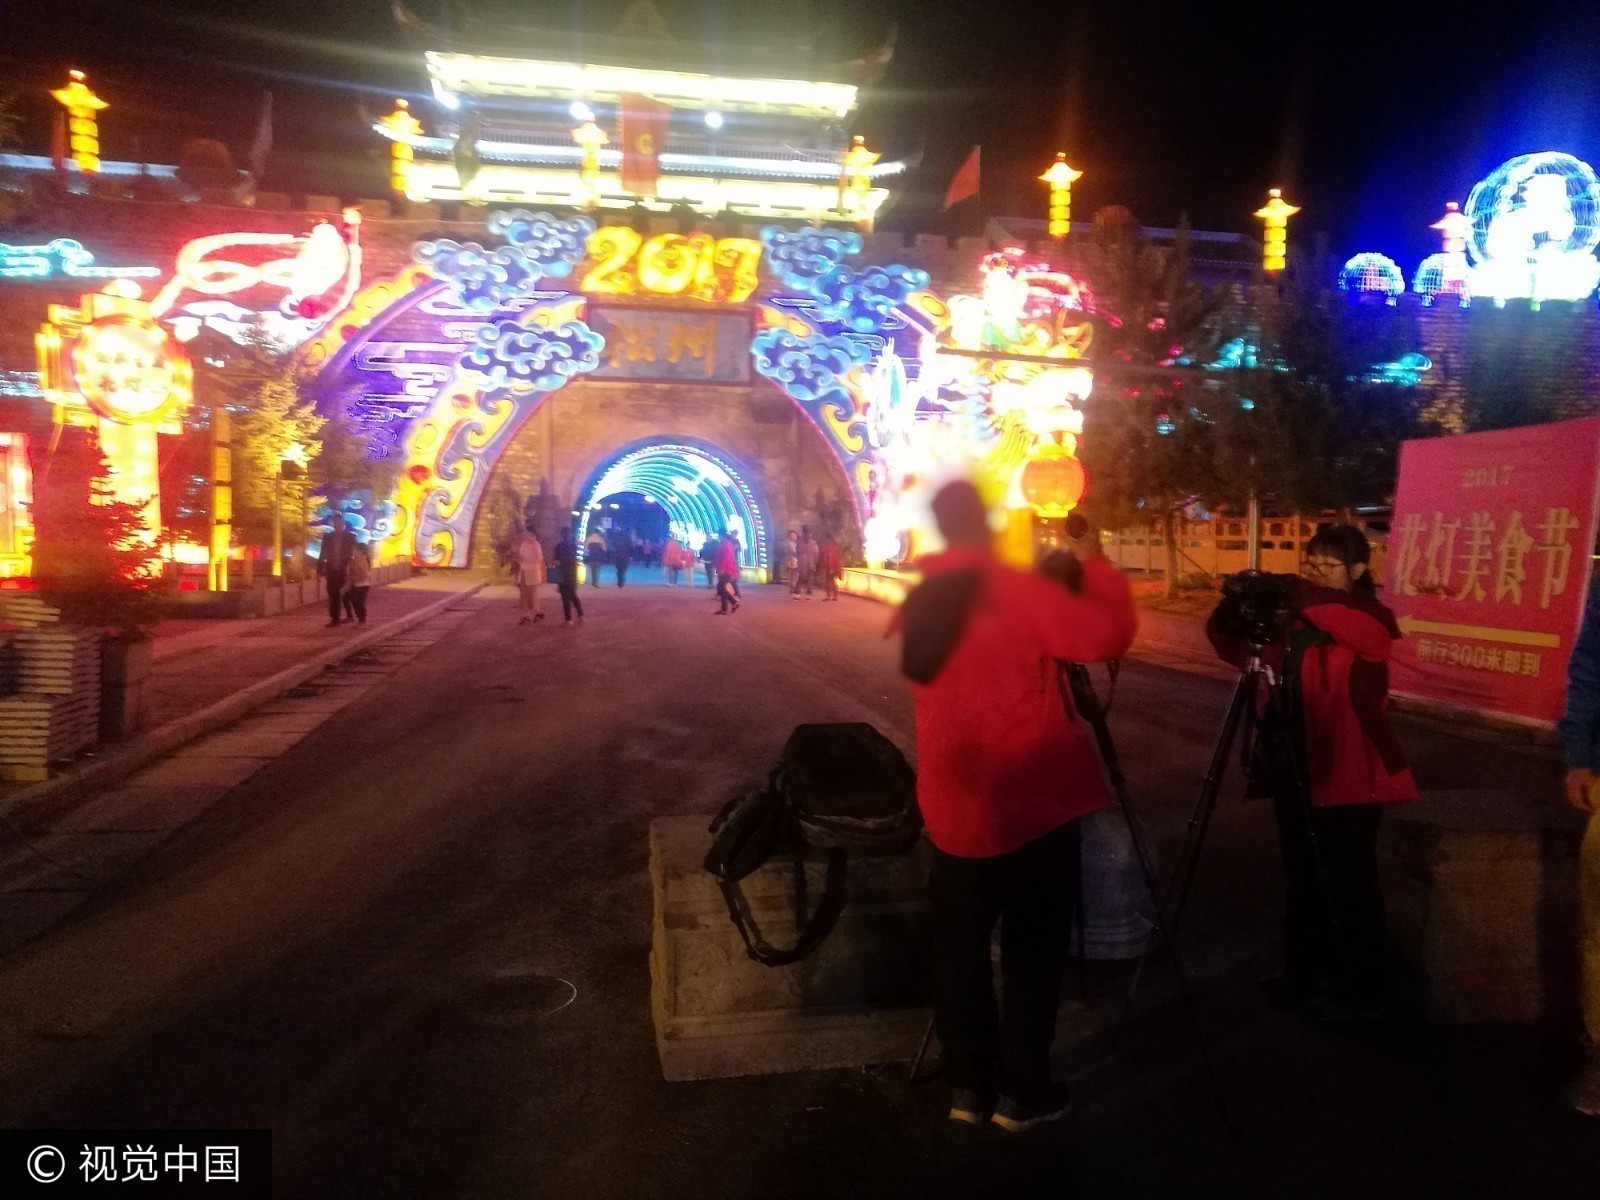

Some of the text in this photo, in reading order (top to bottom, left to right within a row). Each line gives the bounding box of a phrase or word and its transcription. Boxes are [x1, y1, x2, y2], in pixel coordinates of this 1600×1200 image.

[1460, 465, 1515, 488] 2017
[1393, 506, 1580, 610] 花灯美食节
[1416, 638, 1542, 678] 前行300米即到
